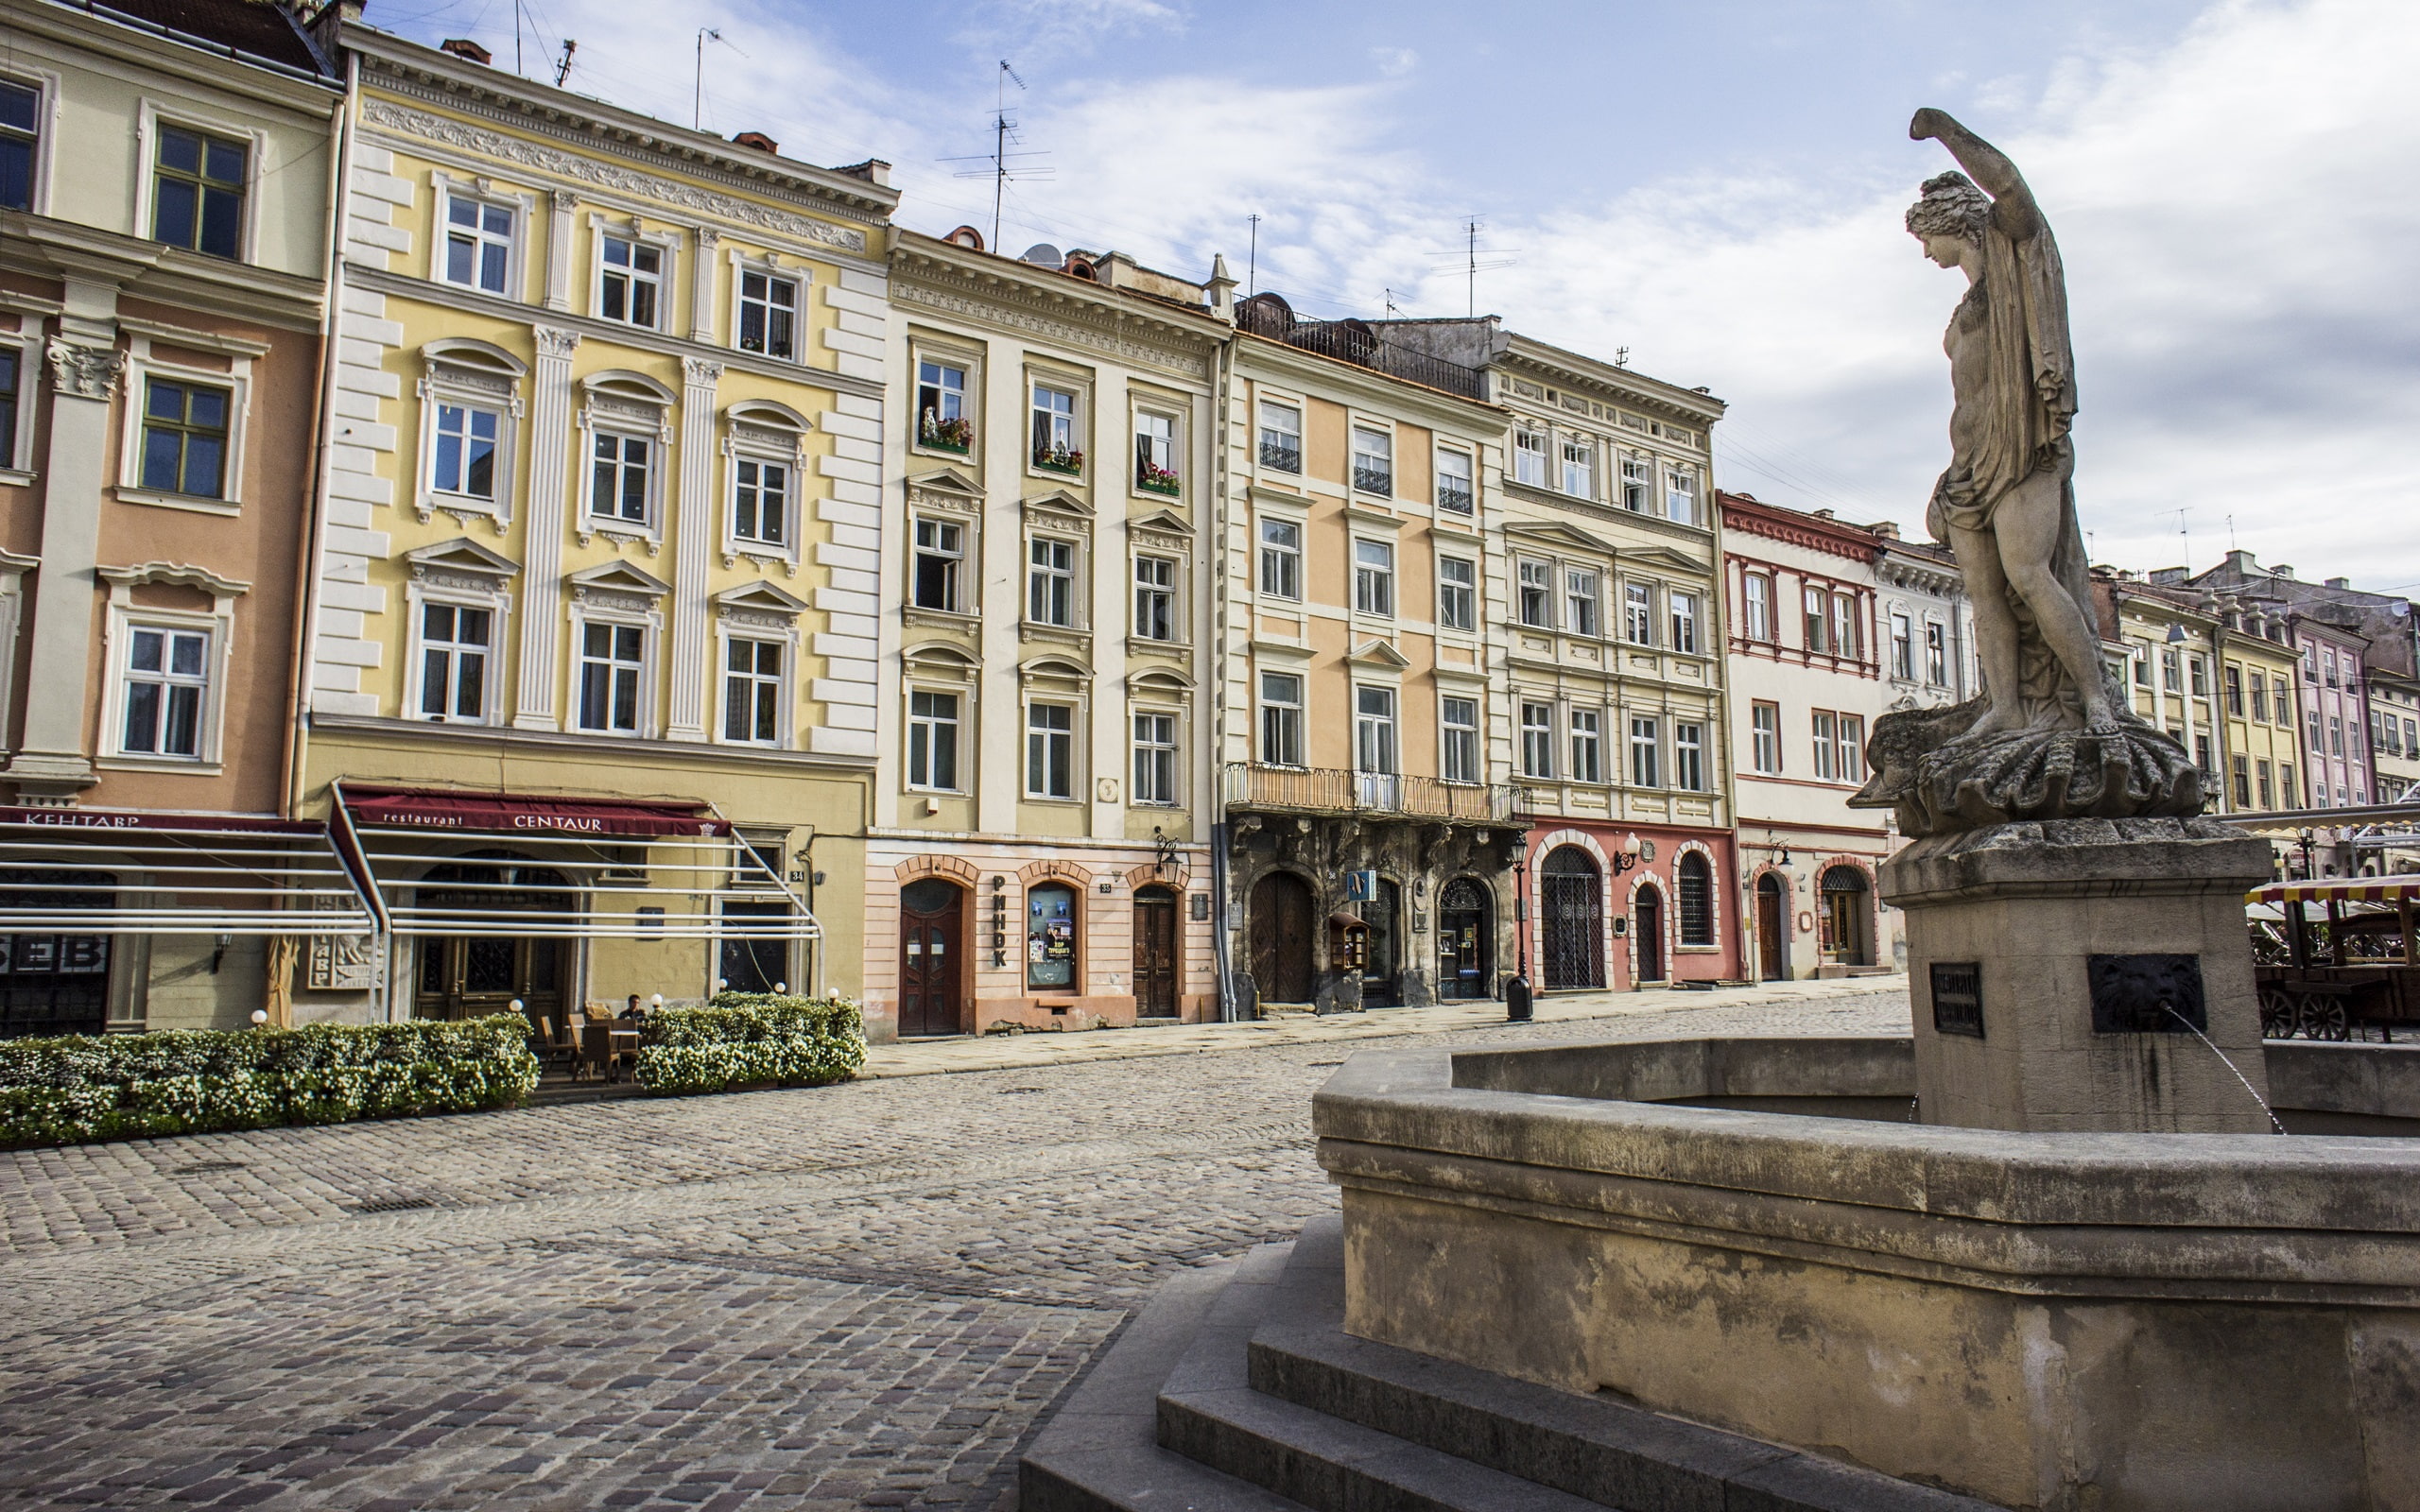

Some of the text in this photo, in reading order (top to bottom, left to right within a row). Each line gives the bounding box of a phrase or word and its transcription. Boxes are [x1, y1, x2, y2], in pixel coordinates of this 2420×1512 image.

[384, 813, 603, 832] restaurant CENTAUR
[792, 871, 804, 881] 34
[0, 935, 102, 968] EB
